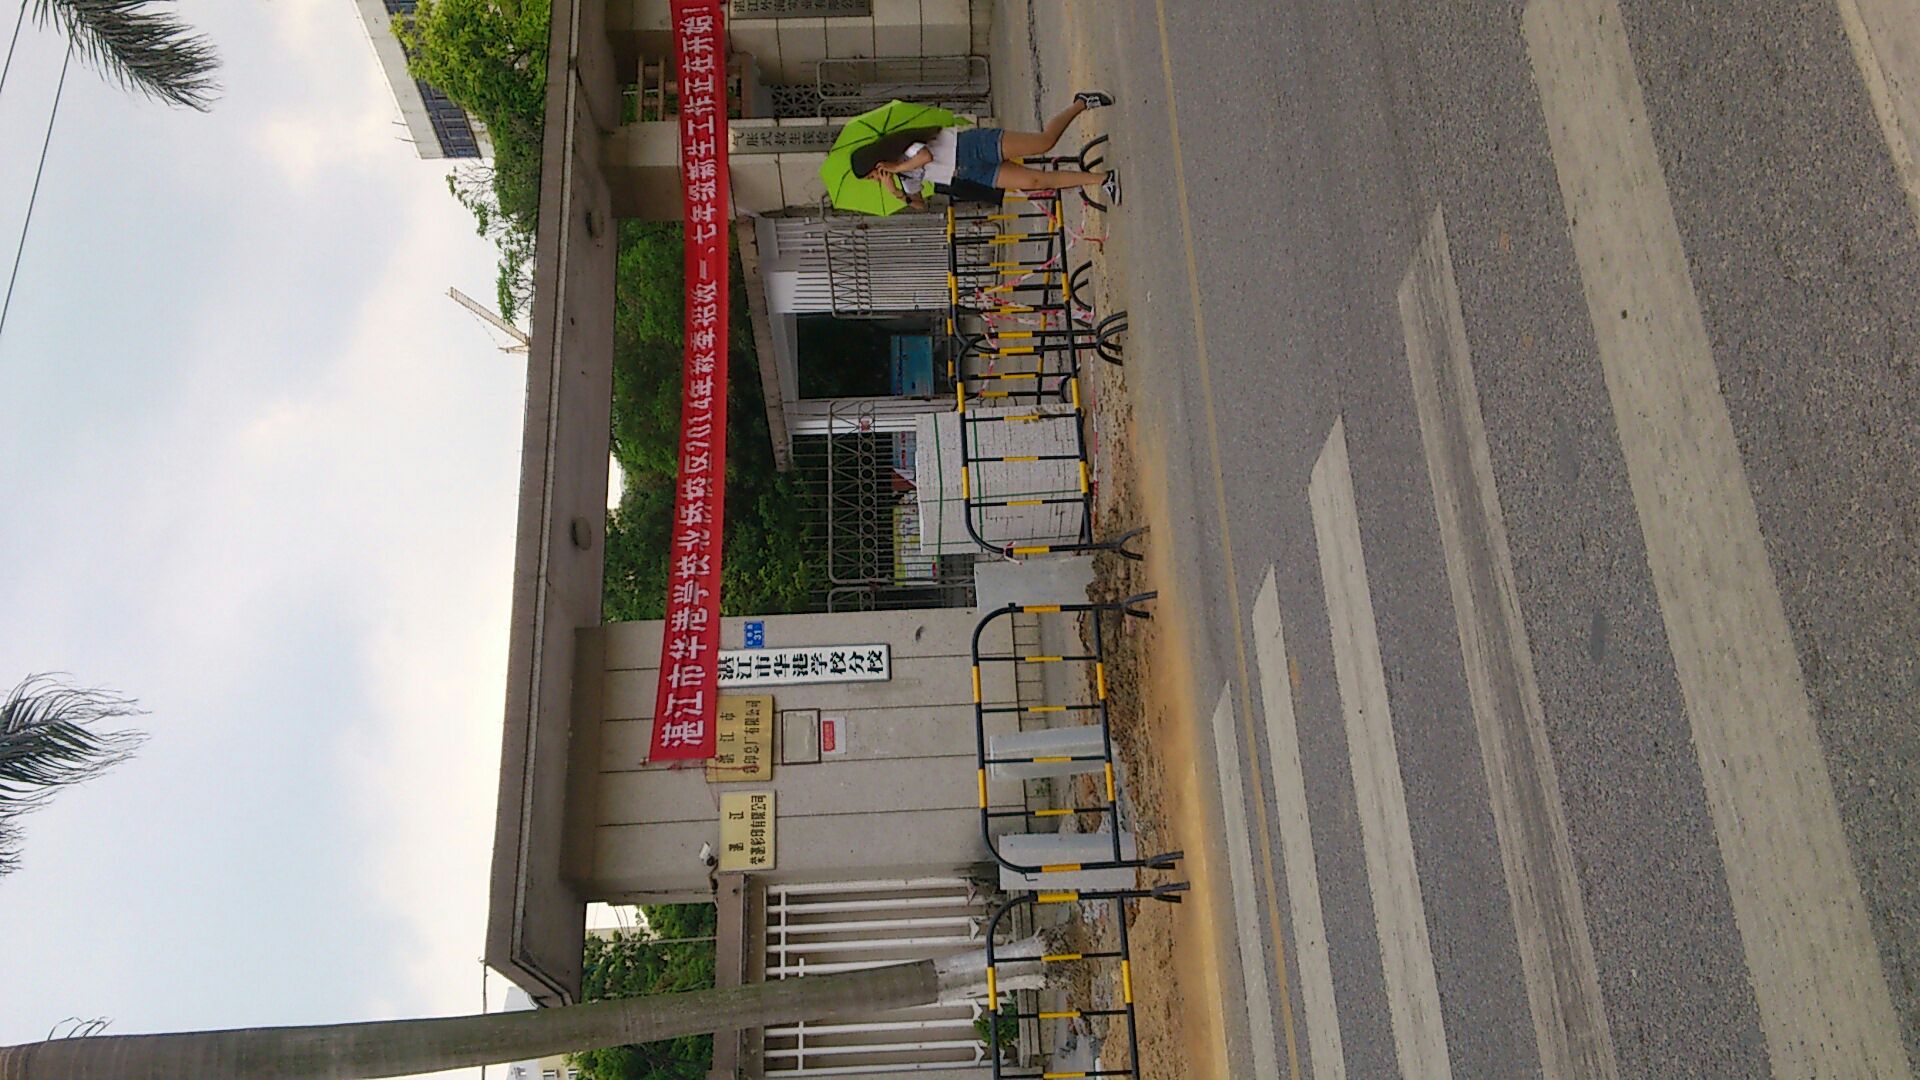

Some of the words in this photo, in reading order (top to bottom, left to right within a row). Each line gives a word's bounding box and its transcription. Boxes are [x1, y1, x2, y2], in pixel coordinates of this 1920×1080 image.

[753, 630, 761, 640] 31
[718, 650, 883, 680] 湛江市华港学校分校
[718, 711, 735, 764] 湛江市
[728, 811, 744, 852] 湛江
